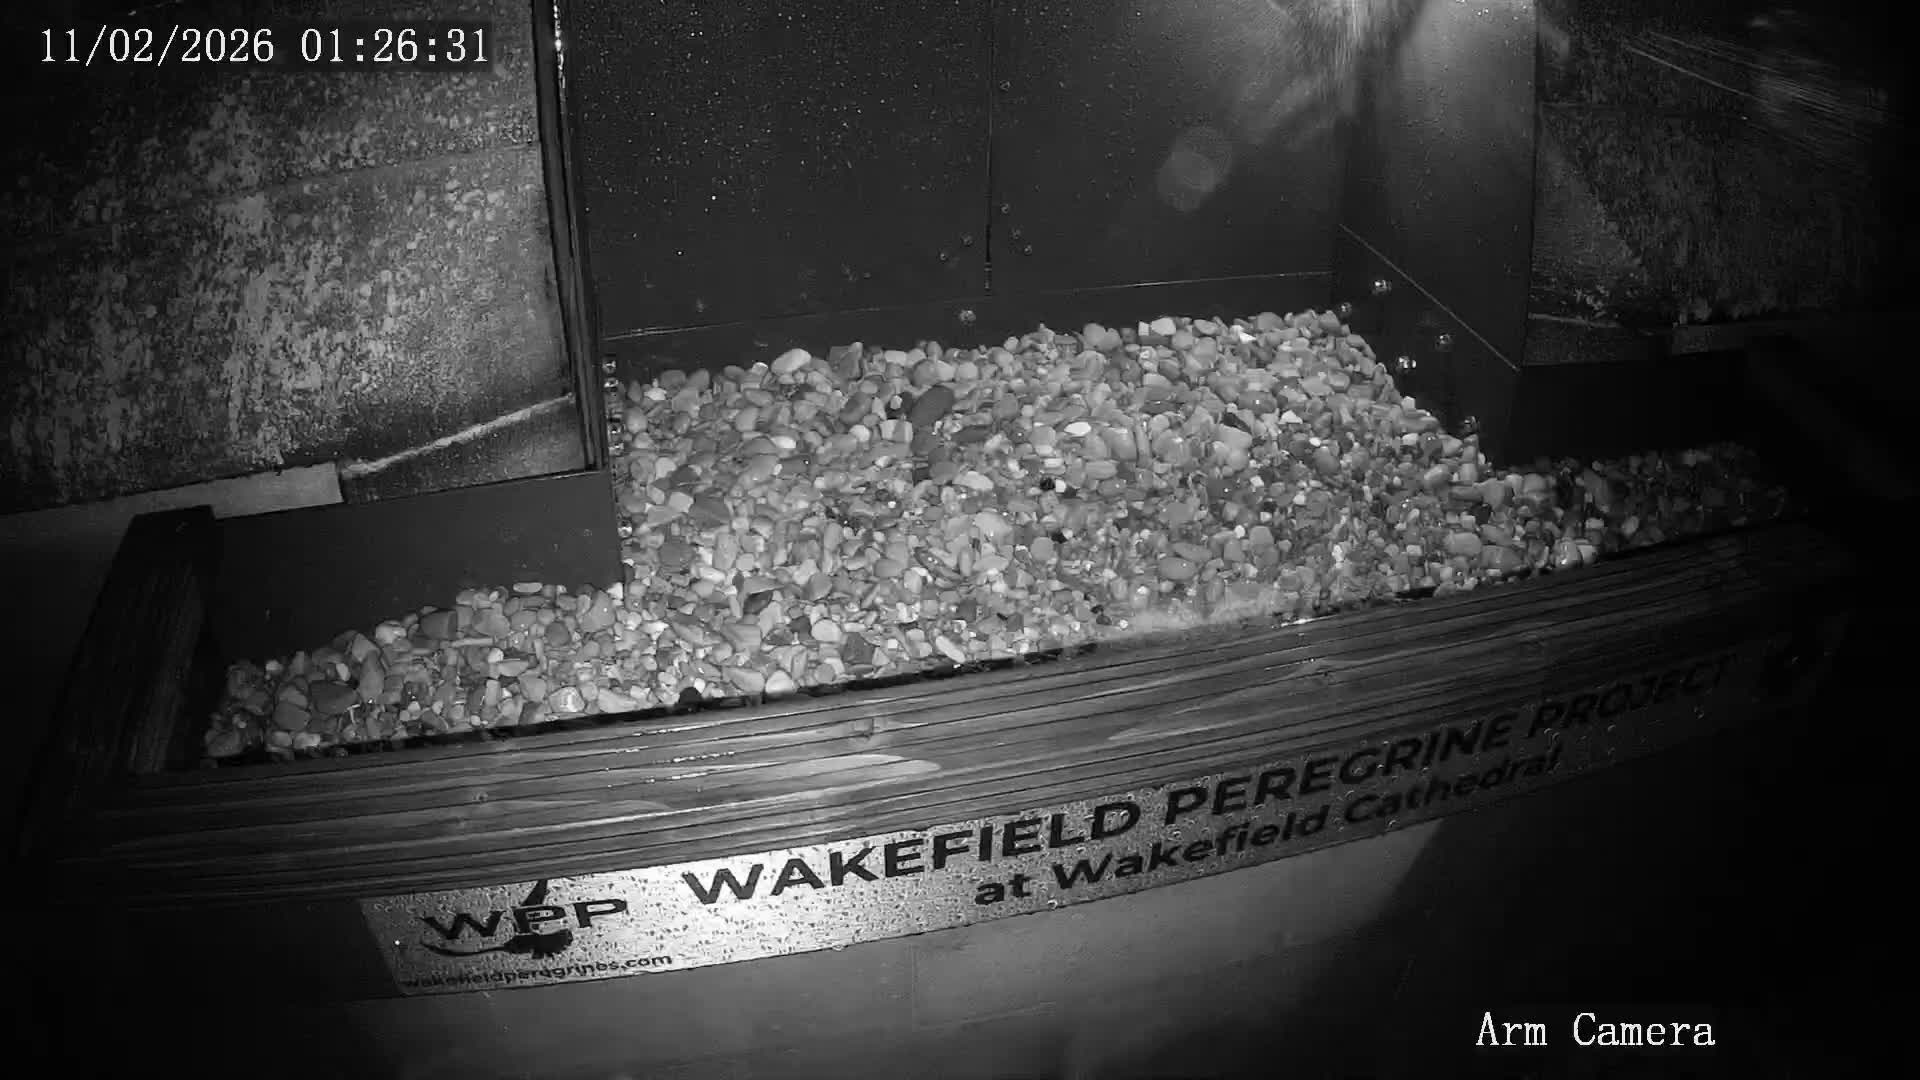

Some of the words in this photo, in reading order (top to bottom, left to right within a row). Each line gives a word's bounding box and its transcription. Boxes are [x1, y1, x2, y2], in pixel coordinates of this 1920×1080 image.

[681, 800, 1142, 905] WAKEFIELD
[1163, 711, 1518, 826] PEREGRINE
[1527, 653, 1738, 739] PROJECT
[975, 872, 1033, 906] at
[1052, 803, 1331, 890] Wakefield
[1344, 743, 1563, 824] Cathedral
[418, 898, 628, 941] WPP
